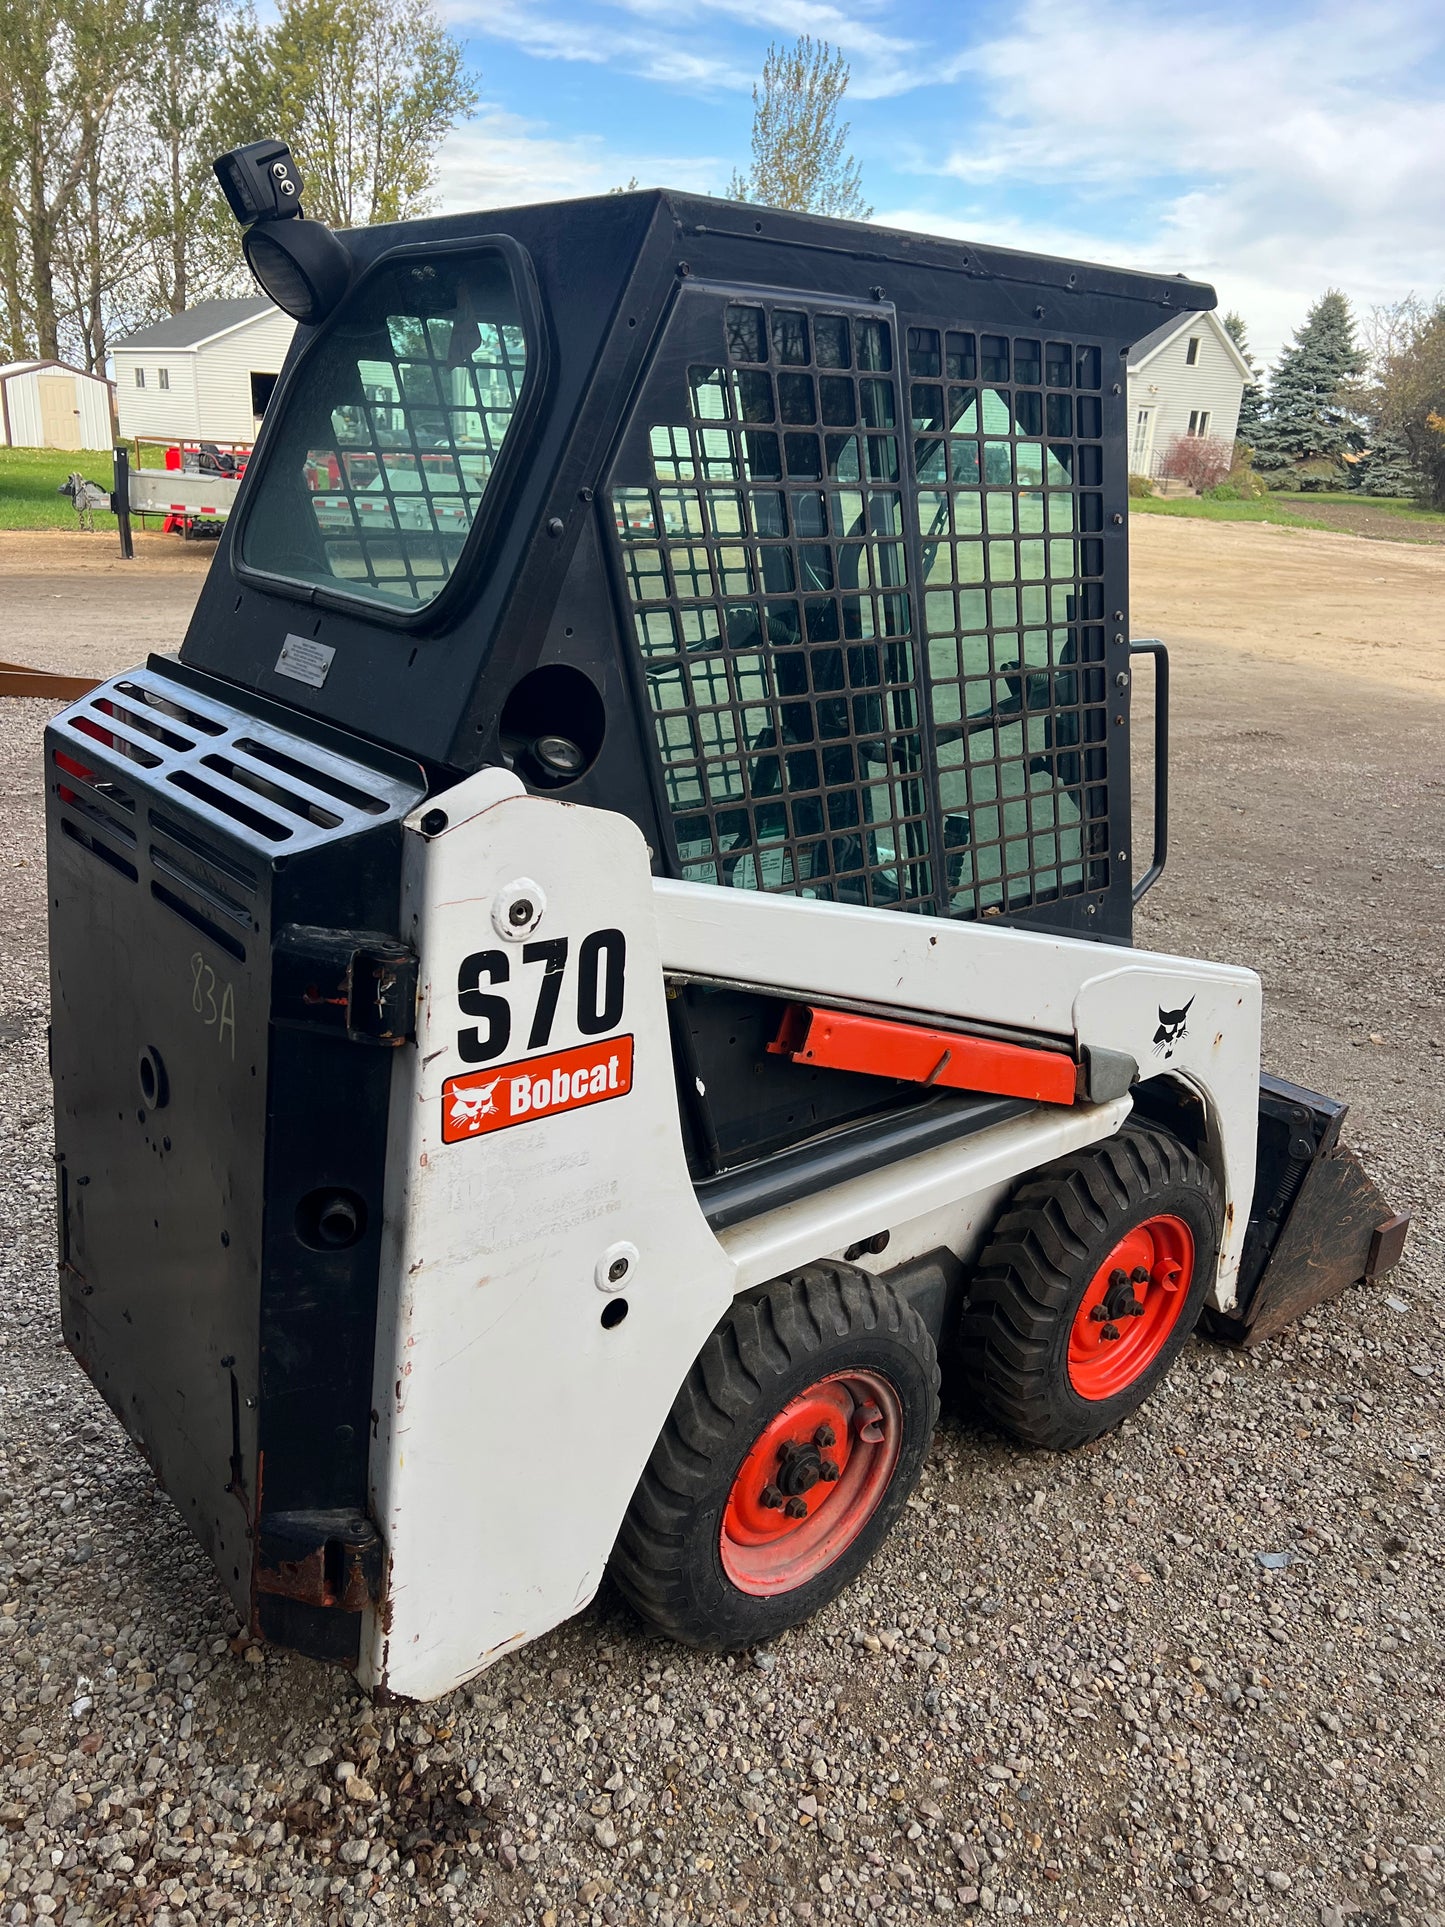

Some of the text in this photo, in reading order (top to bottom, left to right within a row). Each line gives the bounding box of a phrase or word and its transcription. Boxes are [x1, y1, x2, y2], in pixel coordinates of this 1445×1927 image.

[191, 951, 235, 1060] 83A
[458, 928, 626, 1063] S70
[510, 1055, 619, 1117] Bobcat
